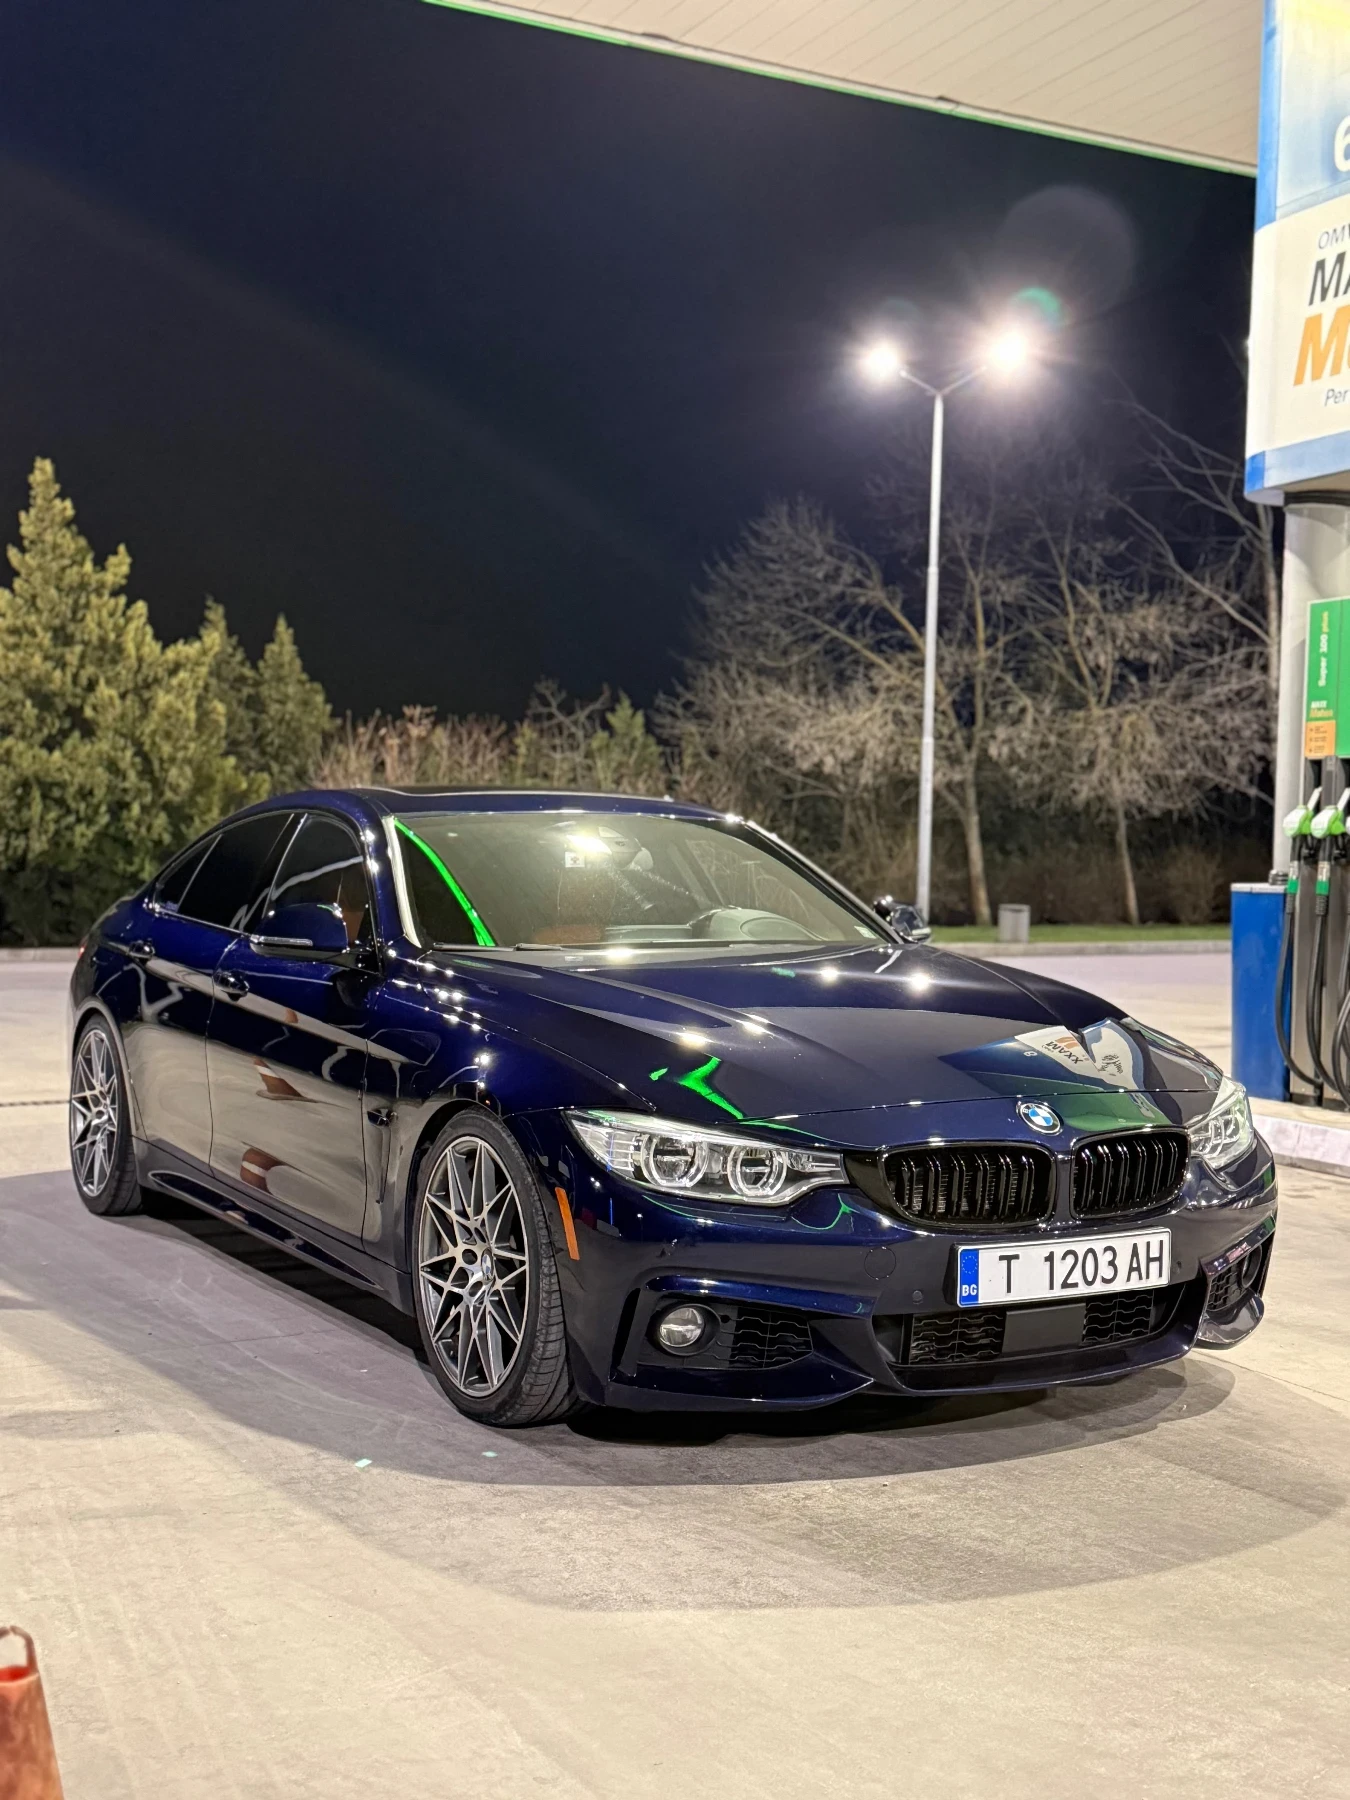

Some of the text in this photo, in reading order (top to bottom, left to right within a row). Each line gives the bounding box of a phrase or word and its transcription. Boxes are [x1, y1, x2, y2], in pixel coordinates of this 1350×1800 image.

[999, 1239, 1164, 1293] T 1203 AH
[962, 1284, 977, 1297] BG
